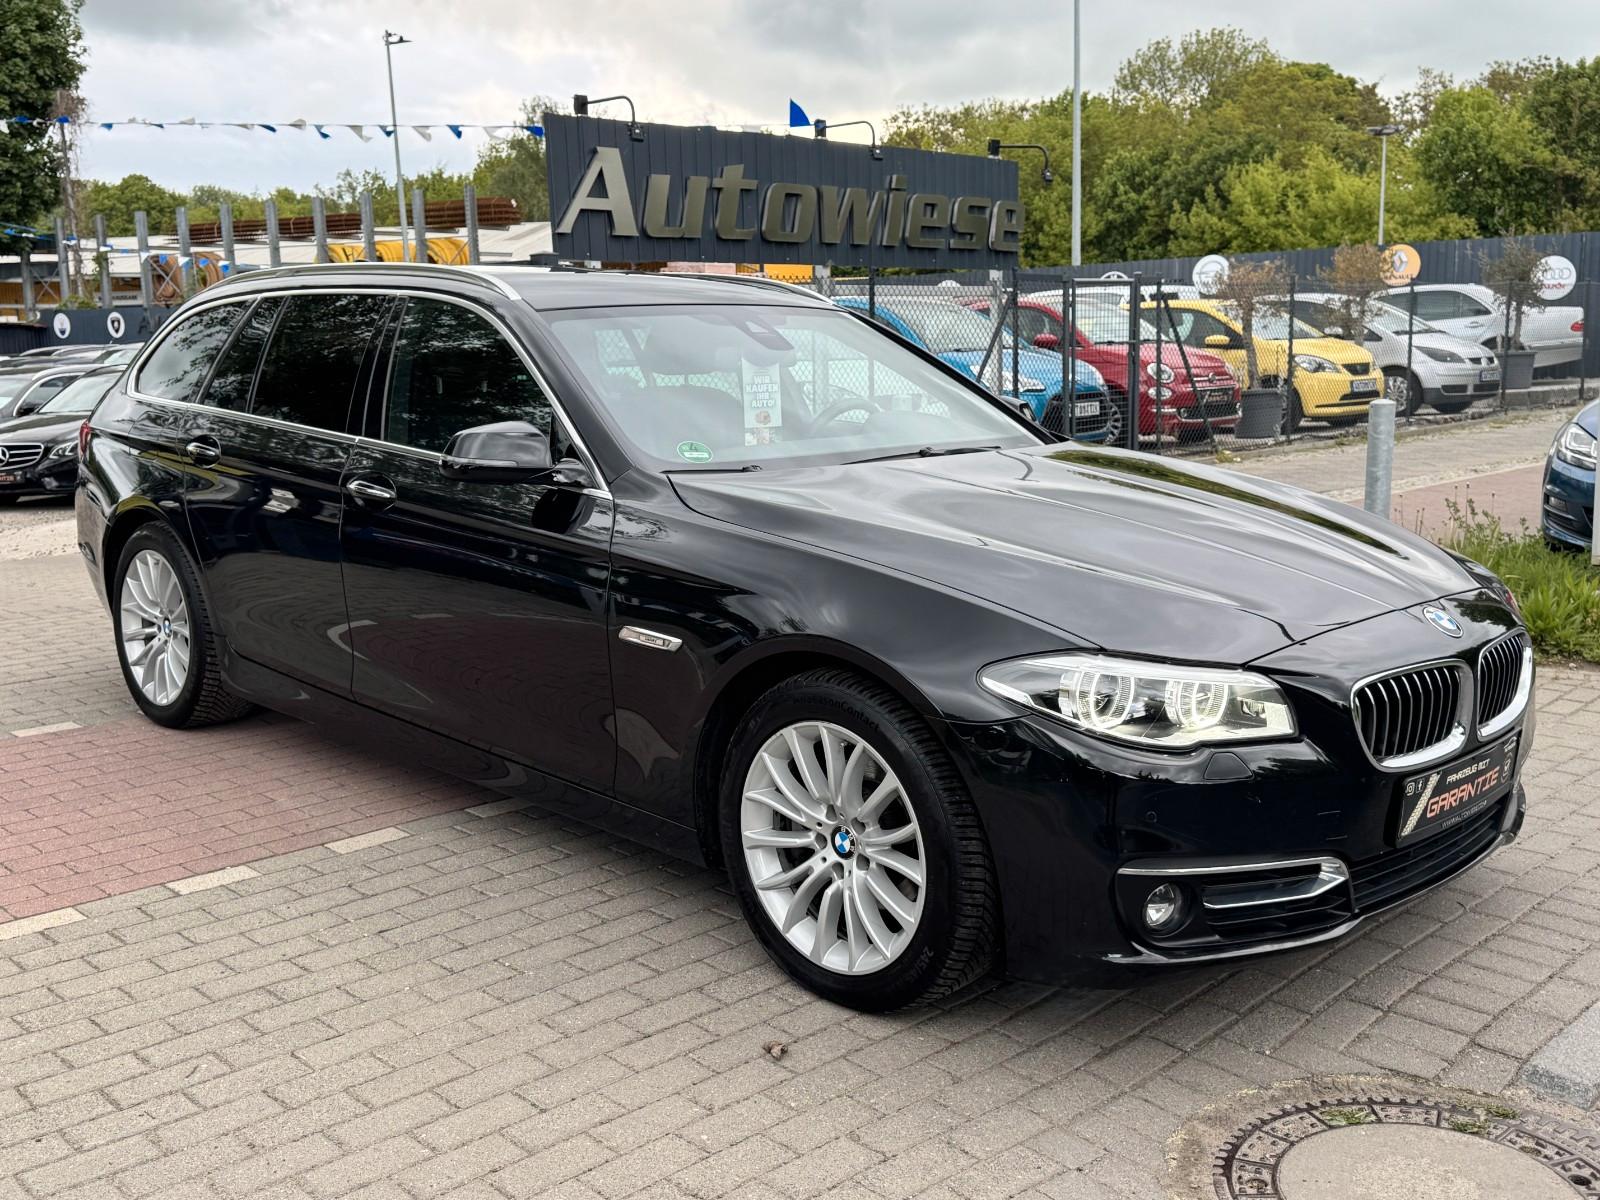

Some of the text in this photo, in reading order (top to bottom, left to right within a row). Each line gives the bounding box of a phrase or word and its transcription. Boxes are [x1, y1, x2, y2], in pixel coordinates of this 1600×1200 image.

[555, 146, 1026, 252] Autowiese
[745, 383, 779, 393] KAUFEN
[1426, 766, 1500, 818] GARANTIE
[1446, 761, 1478, 785] FAHRZEUG
